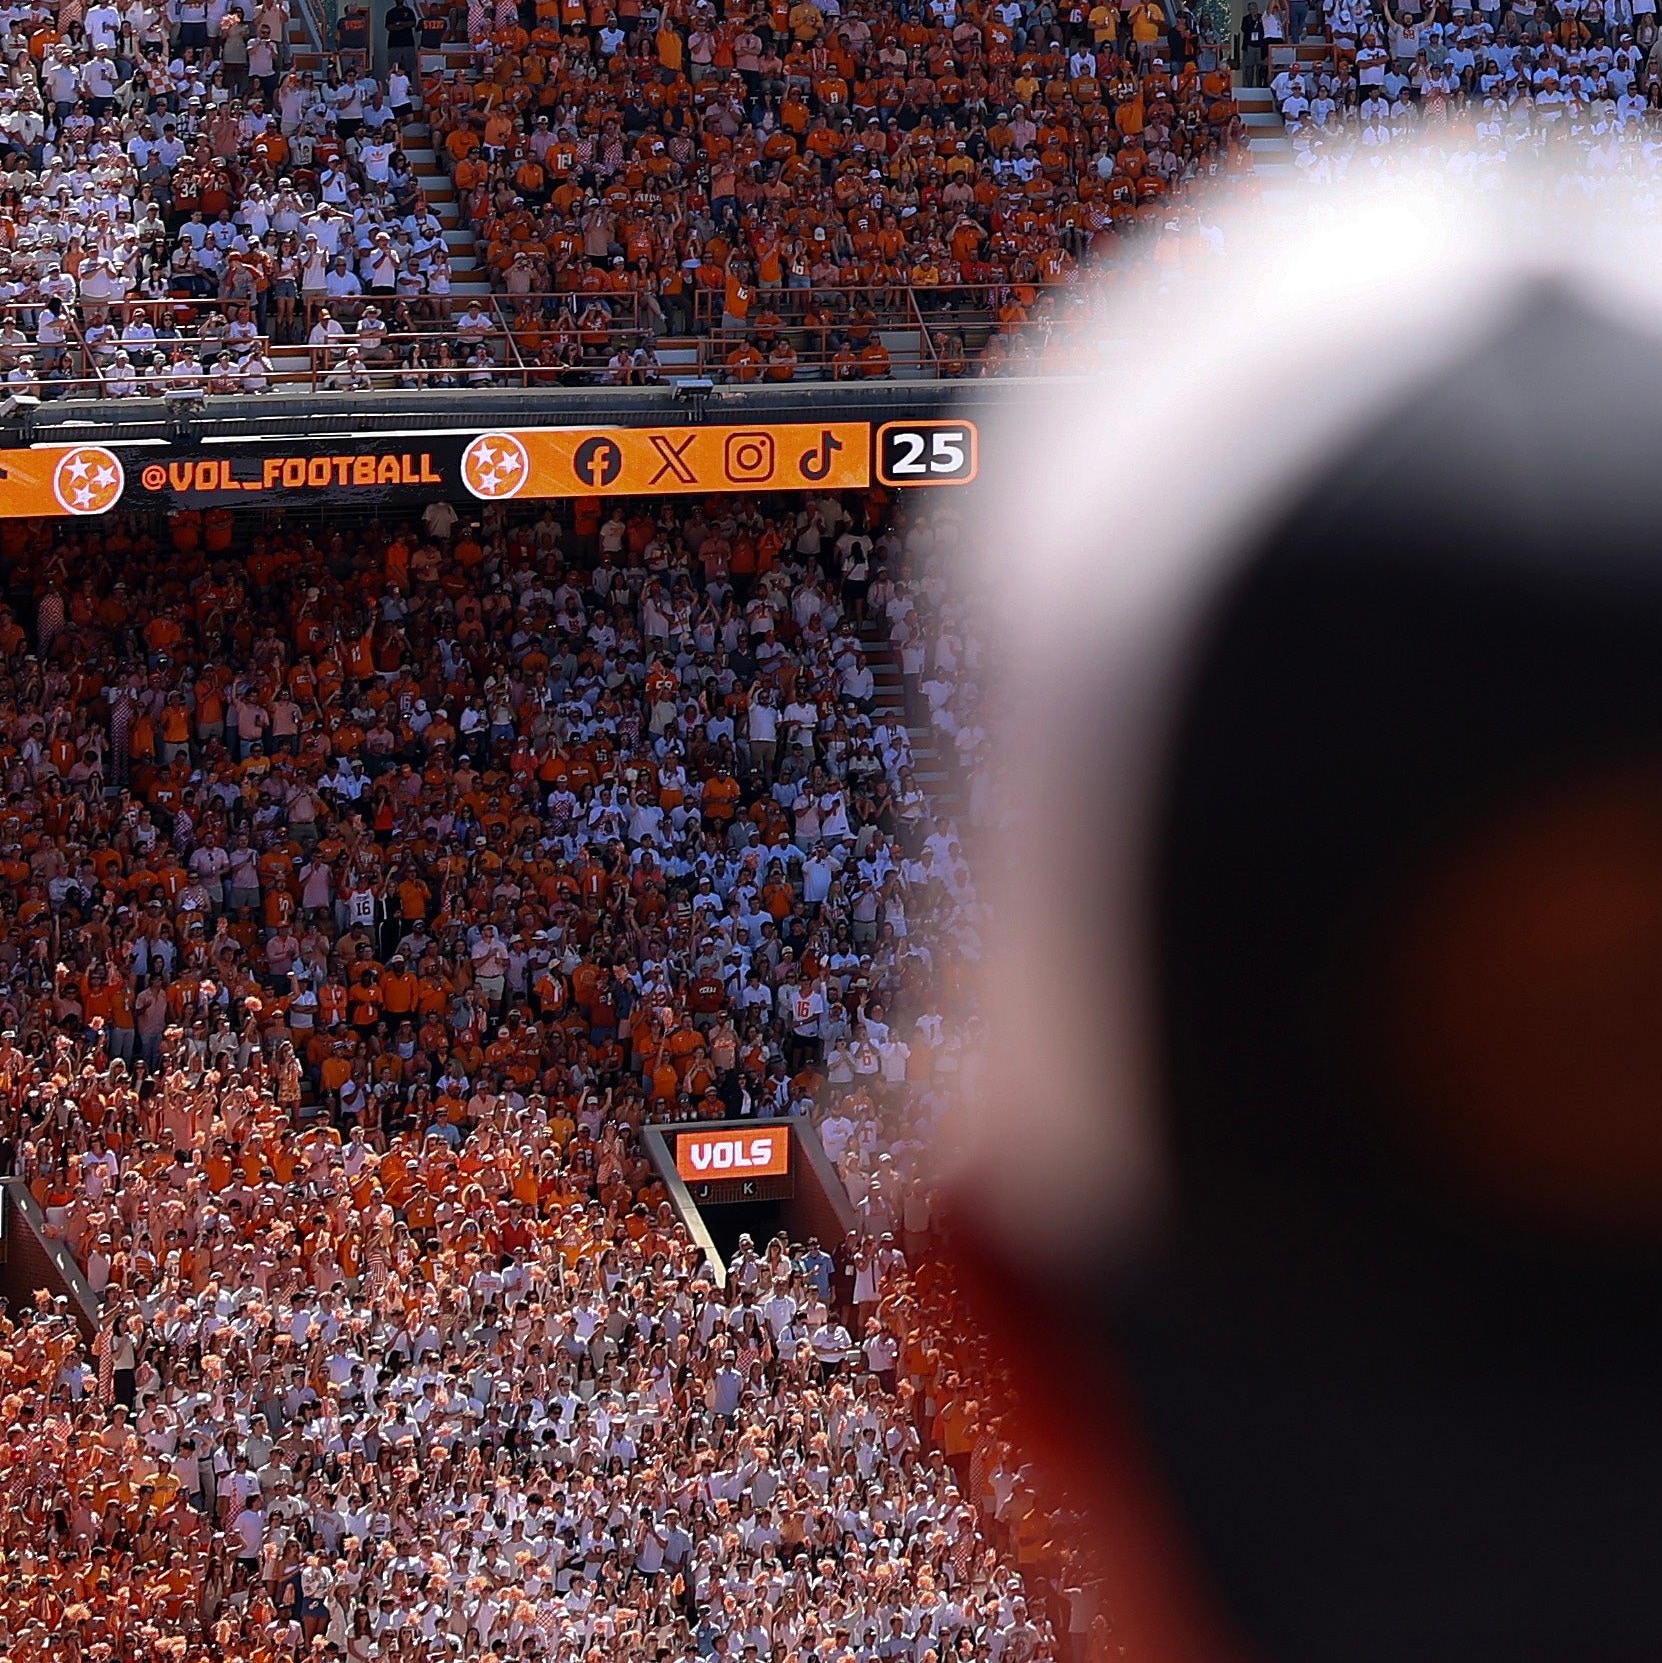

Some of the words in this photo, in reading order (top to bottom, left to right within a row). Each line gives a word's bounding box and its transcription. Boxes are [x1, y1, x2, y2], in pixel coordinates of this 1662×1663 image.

[181, 184, 196, 197] 34
[890, 431, 966, 476] 25
[142, 453, 441, 491] @VOL_FOOTBALL
[357, 901, 370, 916] 16
[691, 1138, 772, 1170] VOLS
[700, 1184, 708, 1197] J
[743, 1182, 753, 1194] K
